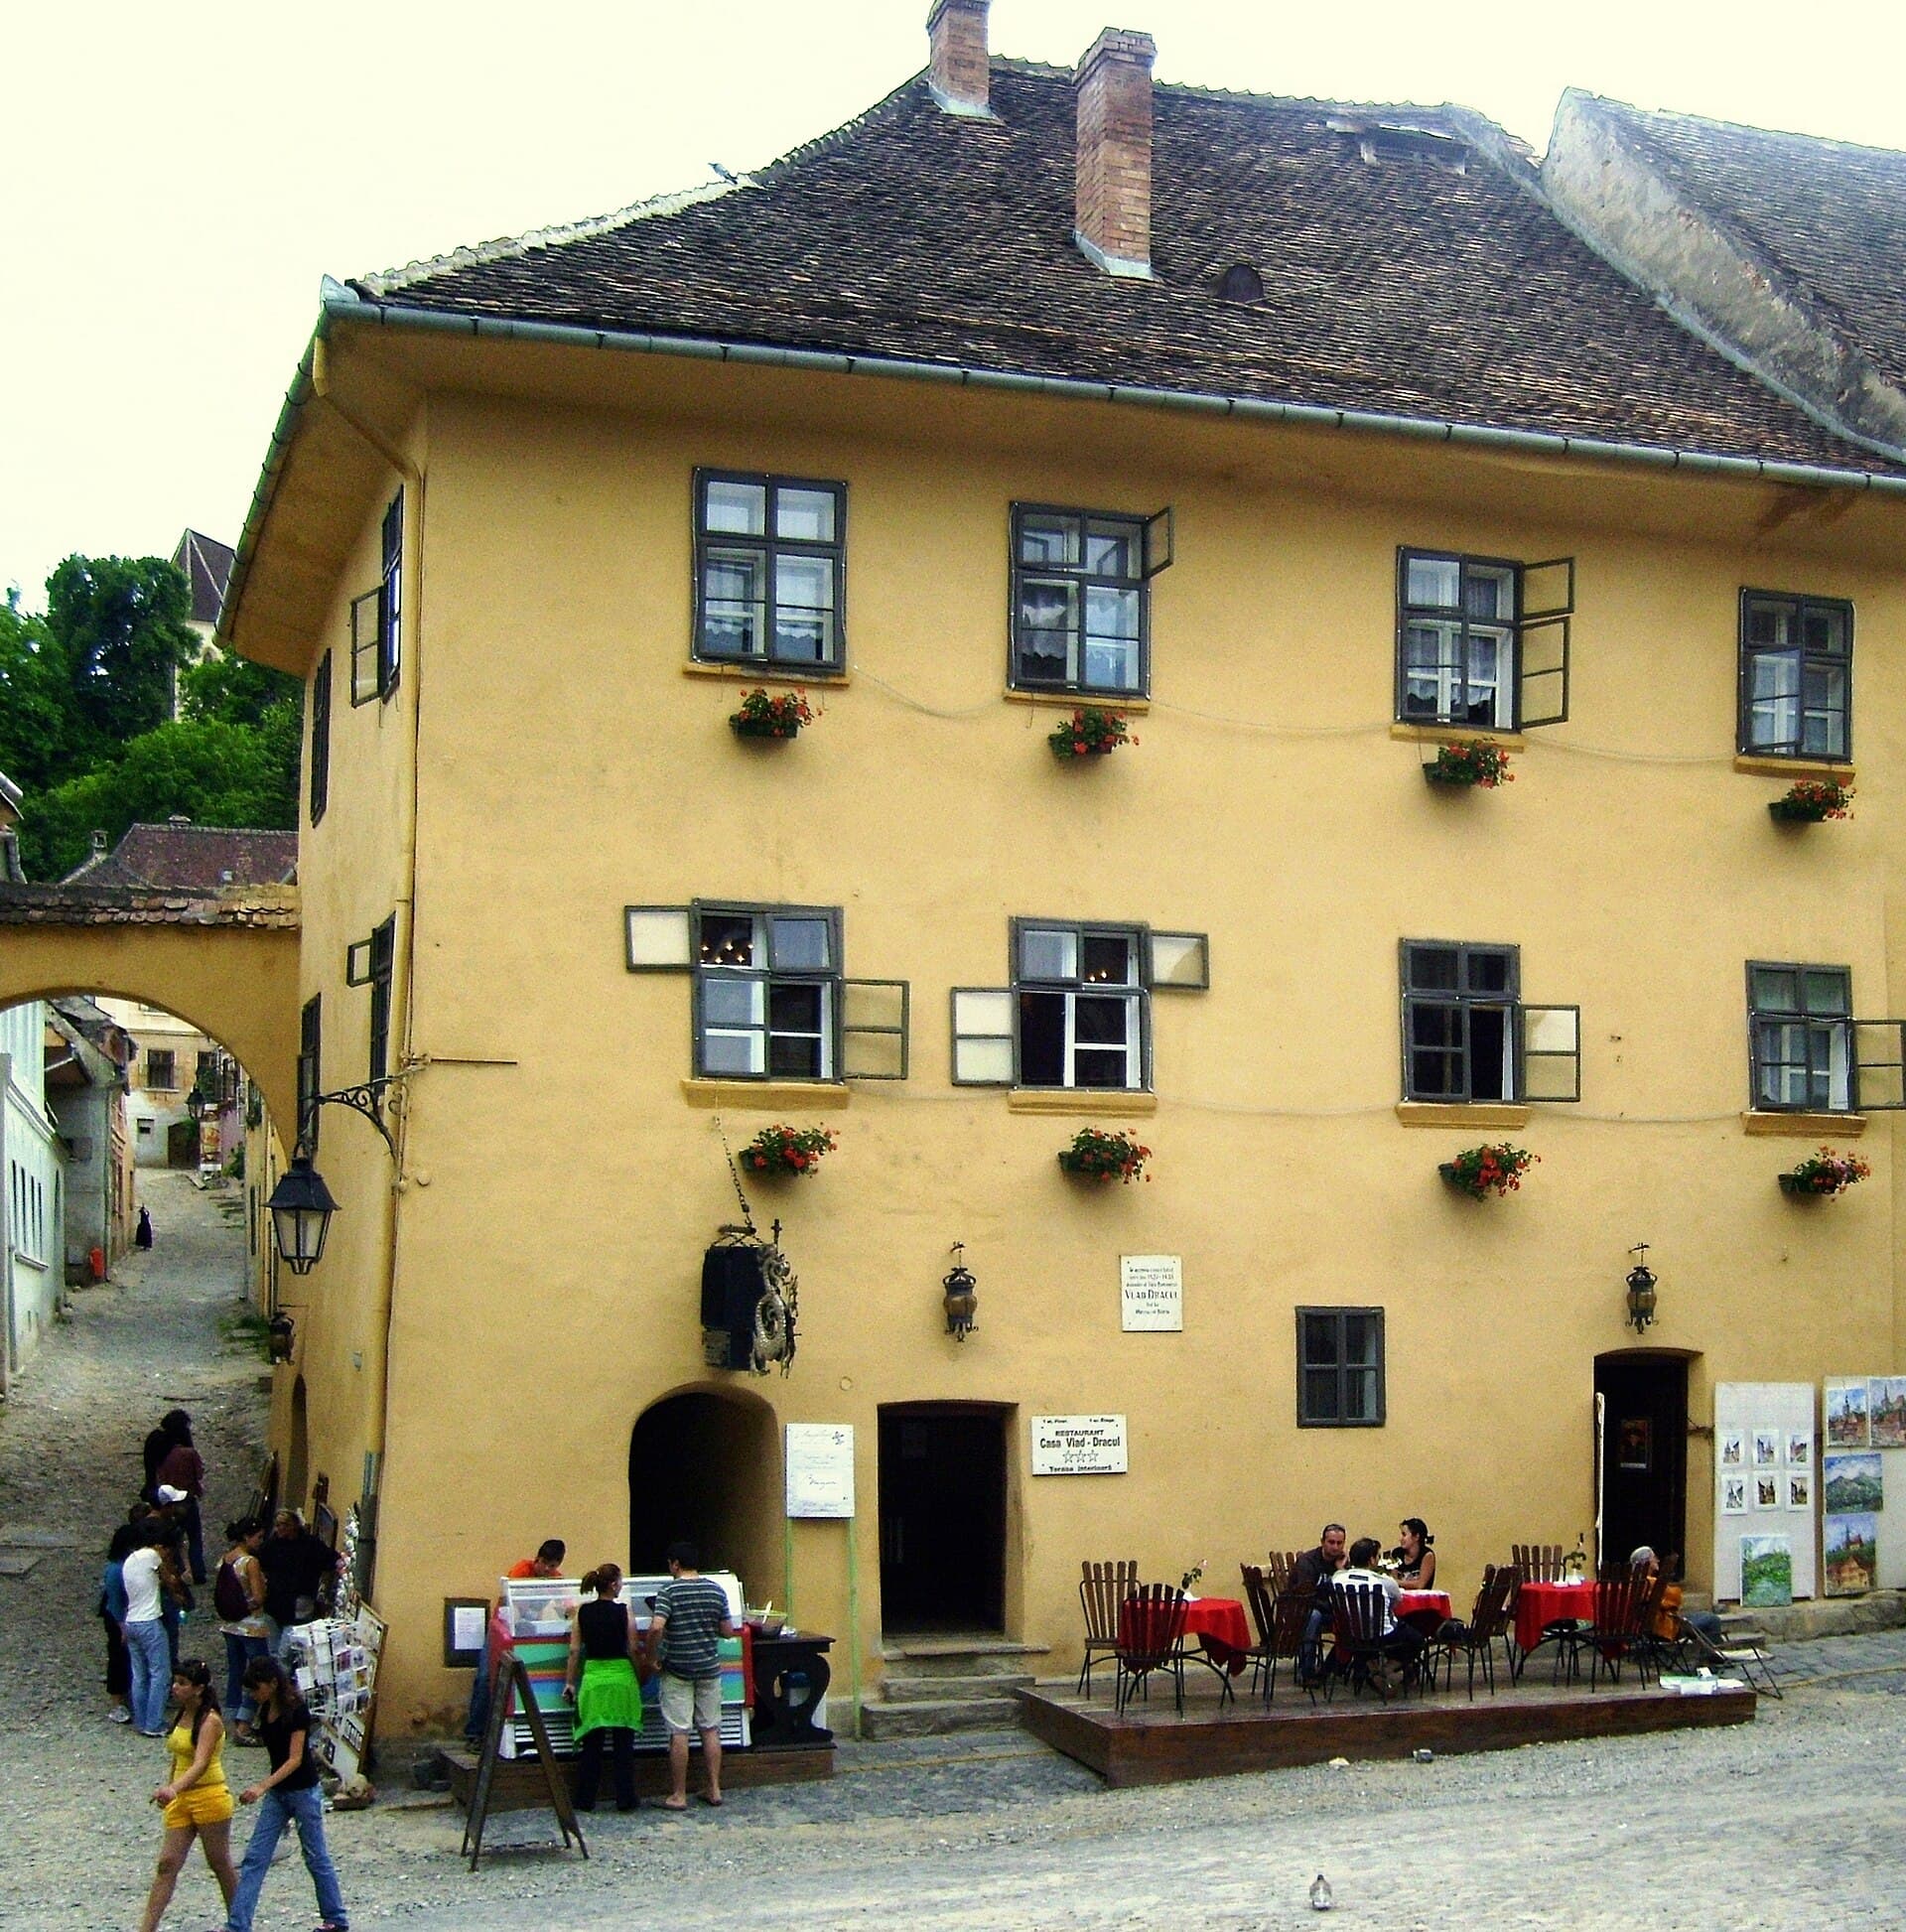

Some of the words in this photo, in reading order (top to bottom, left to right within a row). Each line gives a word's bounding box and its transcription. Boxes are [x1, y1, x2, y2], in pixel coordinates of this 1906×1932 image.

[1039, 1438, 1061, 1449] Casa
[1066, 1437, 1085, 1448] Vlad
[1093, 1436, 1120, 1447] Dracul
